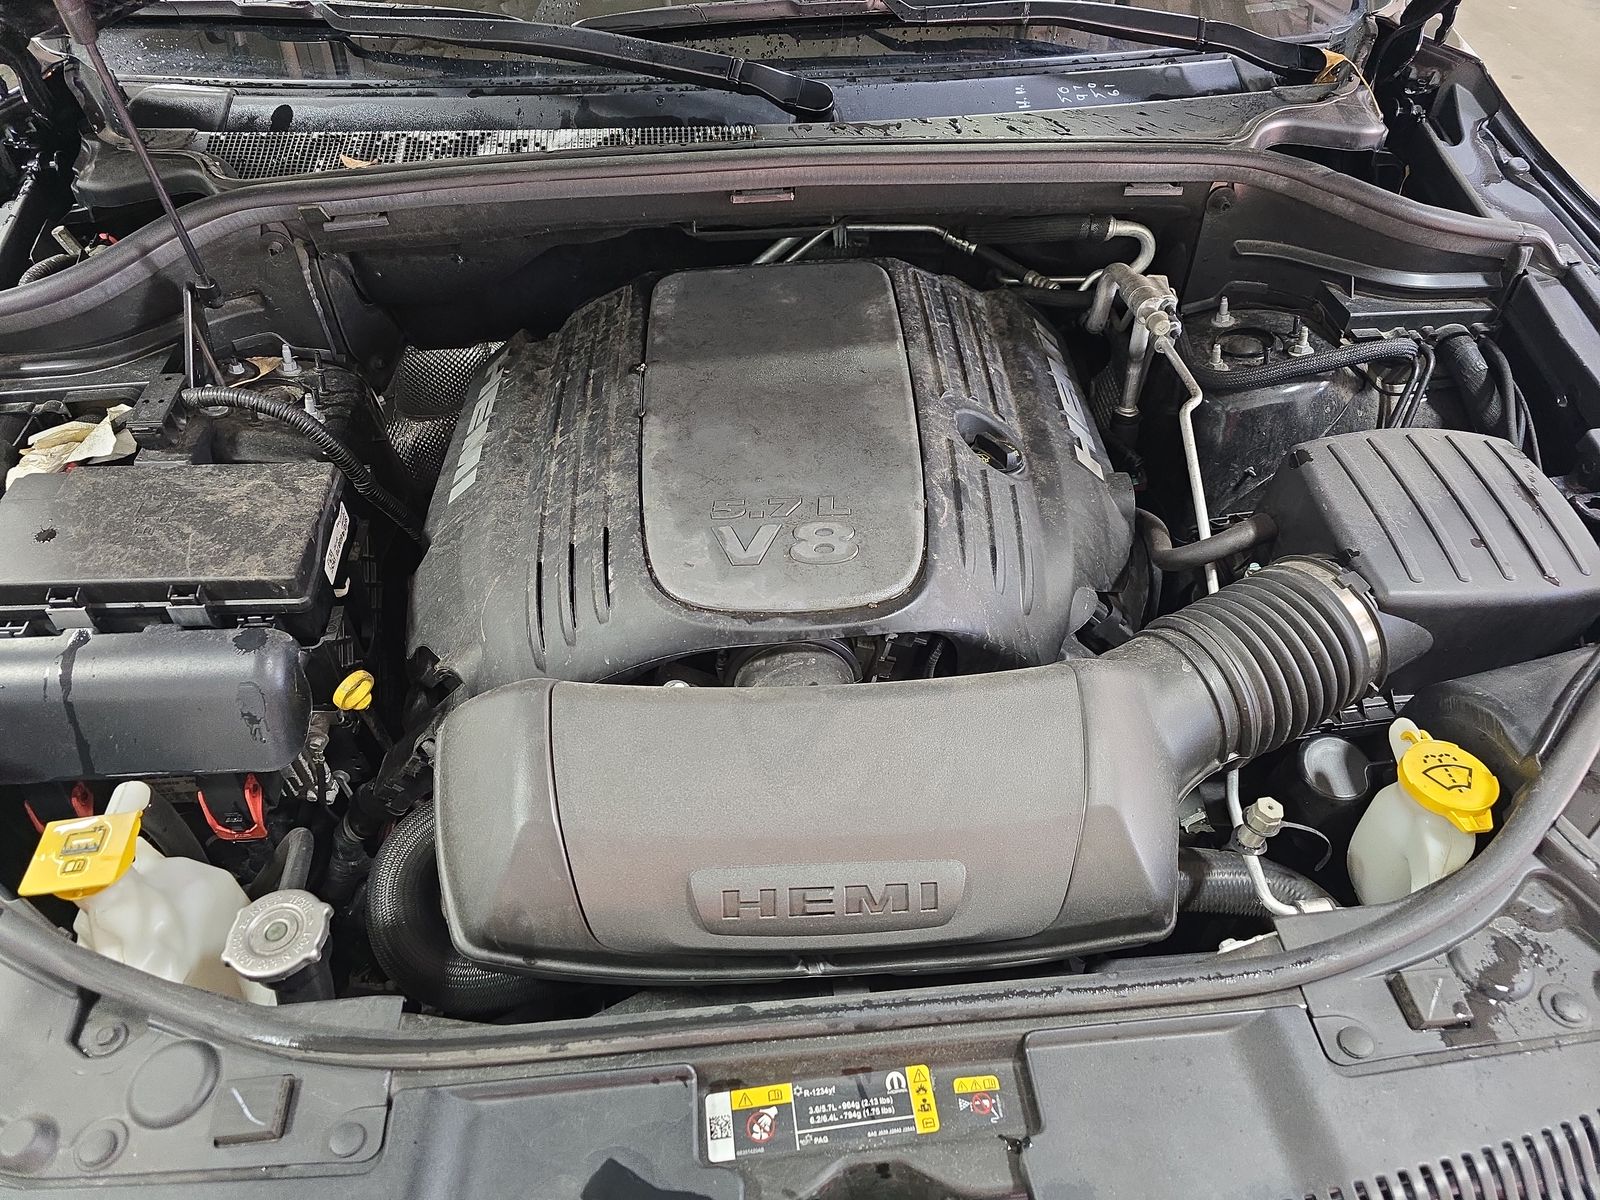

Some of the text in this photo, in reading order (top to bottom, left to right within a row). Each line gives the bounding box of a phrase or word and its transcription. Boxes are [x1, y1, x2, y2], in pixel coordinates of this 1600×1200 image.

[711, 521, 860, 565] V8
[722, 882, 939, 919] HEMI
[803, 1085, 836, 1097] R-1234yf
